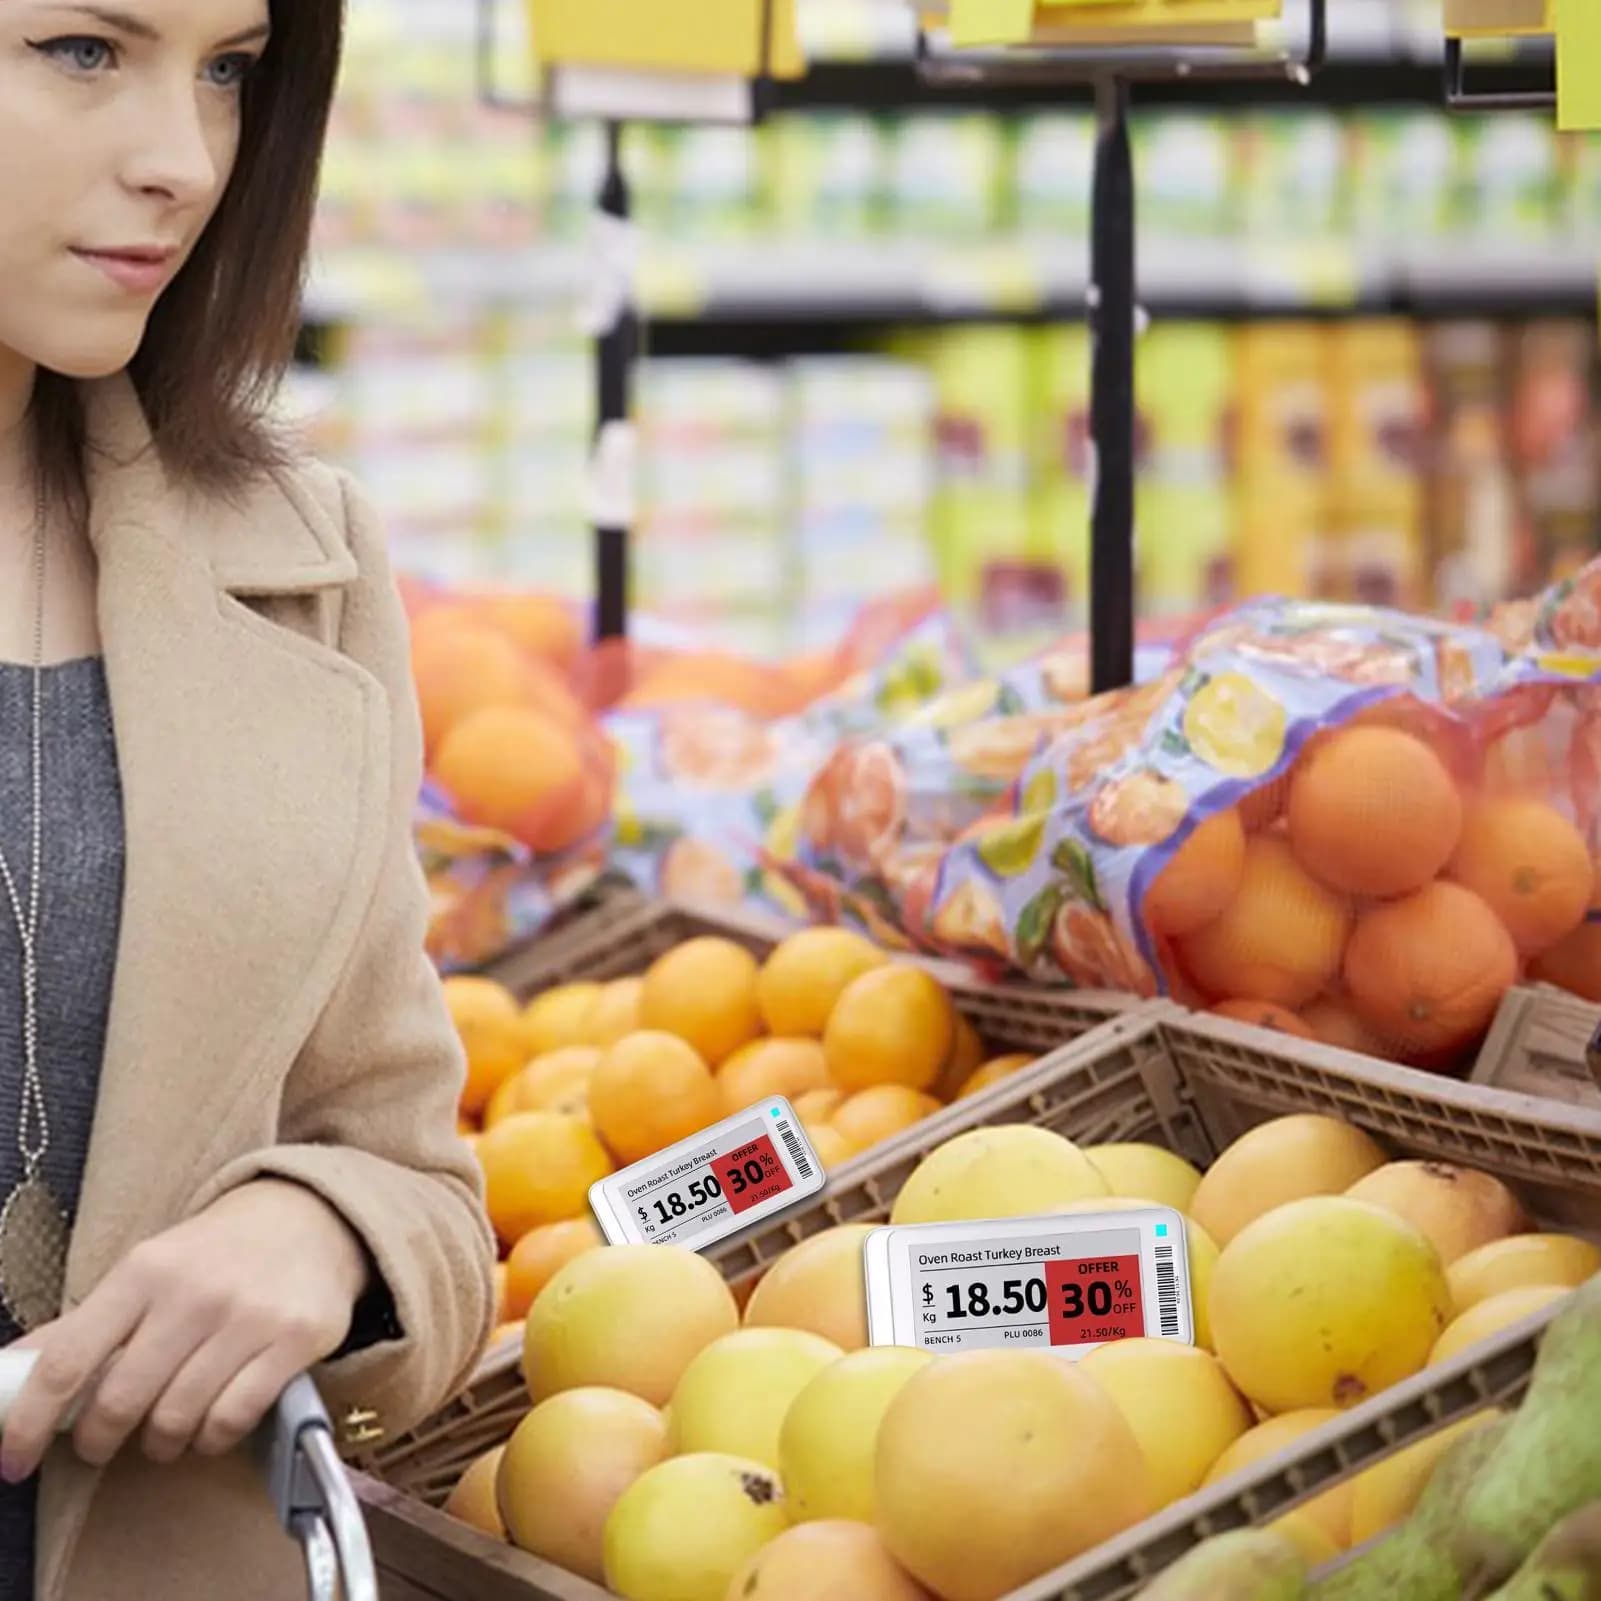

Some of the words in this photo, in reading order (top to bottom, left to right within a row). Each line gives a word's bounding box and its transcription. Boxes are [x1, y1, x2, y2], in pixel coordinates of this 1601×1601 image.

[732, 1144, 759, 1162] OFFER
[627, 1184, 647, 1198] Oven
[647, 1173, 668, 1188] Roast
[668, 1161, 693, 1176] Turkey
[692, 1149, 718, 1164] Breast
[726, 1160, 764, 1195] 30
[760, 1153, 774, 1166] %
[764, 1166, 780, 1178] OFF
[653, 1175, 722, 1224] 18.50
[638, 1206, 648, 1222] $
[701, 1213, 712, 1222] PLU
[644, 1224, 656, 1232] Kg
[918, 1254, 948, 1265] Oven
[950, 1251, 982, 1262] Roast
[984, 1248, 1022, 1260] Turkey
[1024, 1244, 1061, 1257] Breast
[1078, 1261, 1119, 1274] OFFER
[922, 1282, 934, 1304] $
[946, 1278, 1048, 1318] 18.50
[1061, 1280, 1112, 1318] 30
[1114, 1280, 1132, 1298] %
[1112, 1302, 1136, 1314] OFF
[922, 1312, 936, 1324] Kg
[1004, 1330, 1020, 1338] PLU
[1022, 1328, 1044, 1338] 0086
[1080, 1326, 1126, 1338] 21.50/Kg
[924, 1336, 954, 1344] BENCH
